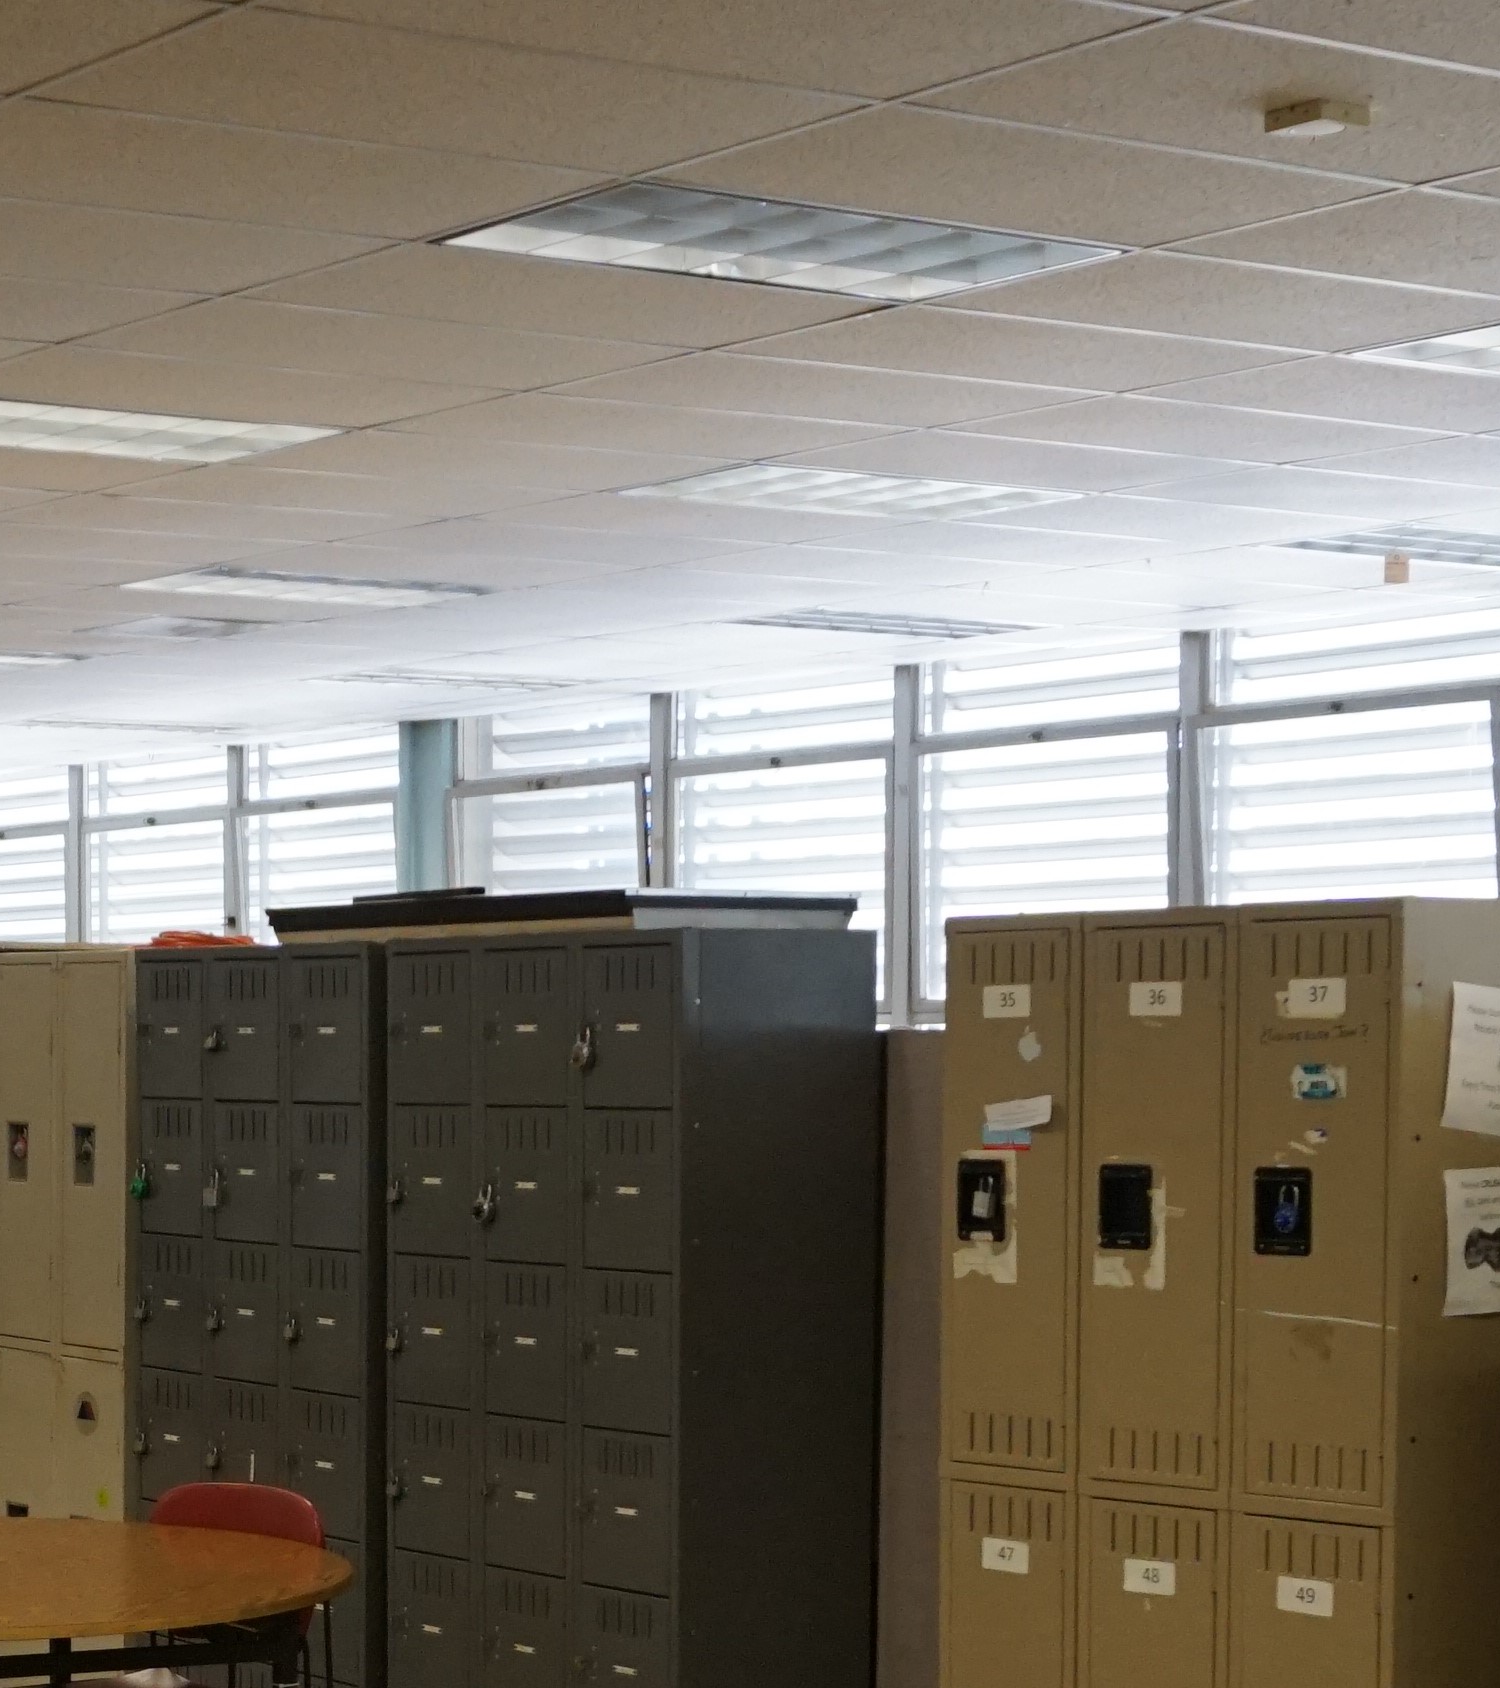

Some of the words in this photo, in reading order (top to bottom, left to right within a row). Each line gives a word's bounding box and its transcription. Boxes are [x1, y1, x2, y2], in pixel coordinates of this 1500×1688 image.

[999, 992, 1016, 1008] 35
[1148, 988, 1167, 1006] 36
[1308, 985, 1329, 1003] 37
[997, 1546, 1015, 1561] 47
[1142, 1568, 1160, 1584] 48
[1295, 1586, 1316, 1604] 49
